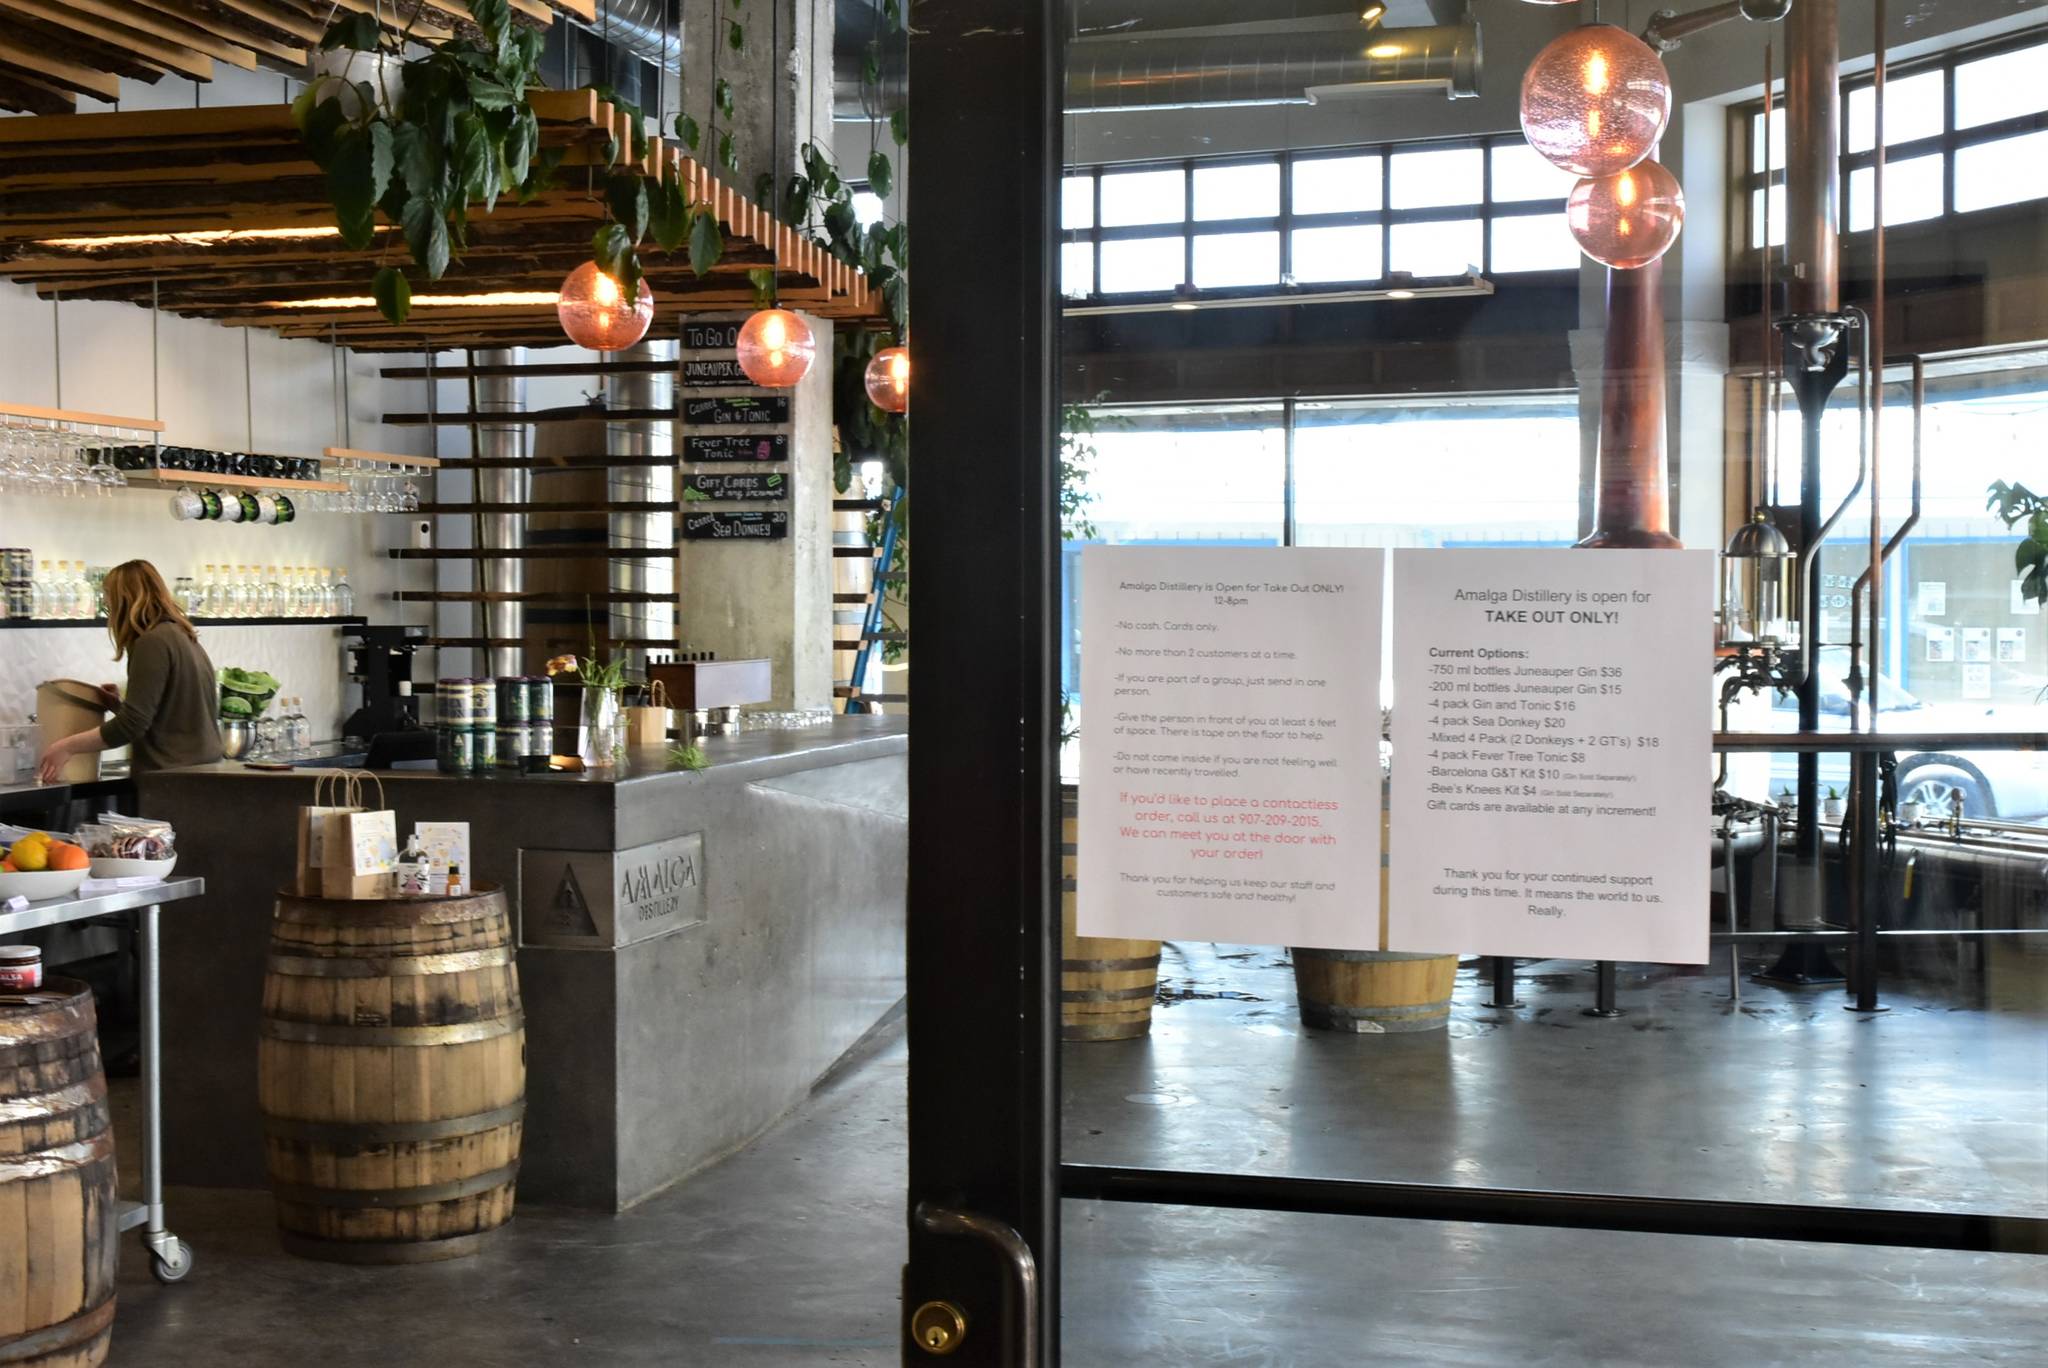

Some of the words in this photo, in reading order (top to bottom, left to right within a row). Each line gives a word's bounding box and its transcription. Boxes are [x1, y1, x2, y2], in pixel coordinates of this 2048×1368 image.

[688, 328, 703, 346] To
[706, 328, 721, 346] Go
[686, 362, 733, 376] JUNEAUPER
[692, 438, 724, 448] Fever
[726, 437, 751, 447] Tree
[704, 449, 735, 458] Tonic
[714, 488, 724, 497] at
[688, 513, 715, 530] Canned
[734, 521, 771, 537] DONKEY
[1119, 581, 1156, 591] Amalga
[1159, 581, 1203, 592] Distillery
[1205, 582, 1213, 591] is
[1215, 582, 1243, 592] Open
[1245, 583, 1260, 591] for
[1263, 583, 1287, 592] Take
[1290, 583, 1309, 592] Out
[1214, 595, 1248, 606] 12-8pm
[1454, 588, 1507, 604] Amalga
[1512, 588, 1572, 604] Distillery
[1576, 590, 1587, 601] is
[1592, 592, 1627, 605] open
[1631, 590, 1651, 602] for
[1484, 610, 1527, 622] TAKE
[1532, 610, 1565, 623] OUT
[1163, 621, 1193, 630] Cards
[1429, 647, 1474, 657] Current
[1456, 665, 1470, 674] ml
[1473, 665, 1511, 675] bottles
[1513, 666, 1574, 678] Juneauper
[1576, 666, 1597, 676] Gin
[1600, 666, 1622, 677] $36
[1456, 682, 1470, 691] ml
[1473, 682, 1510, 692] bottles
[1513, 683, 1574, 695] Juneauper
[1576, 683, 1596, 694] Gin
[1600, 683, 1621, 694] $15
[1442, 698, 1469, 710] pack
[1471, 698, 1492, 709] Gin
[1494, 700, 1516, 709] and
[1519, 699, 1551, 710] Tonic
[1553, 700, 1575, 710] $16
[1442, 715, 1469, 727] pack
[1472, 715, 1494, 726] Sea
[1498, 716, 1540, 729] Donkey
[1544, 717, 1565, 728] $20
[1468, 733, 1475, 741] 4
[1479, 733, 1506, 743] Pack
[1524, 734, 1574, 747] Donkeys
[1588, 735, 1595, 745] 2
[1637, 736, 1659, 747] $18
[1441, 749, 1468, 761] pack
[1471, 749, 1504, 760] Fever
[1506, 750, 1533, 761] Tree
[1536, 751, 1568, 762] Tonic
[1570, 752, 1585, 762] $8
[1520, 768, 1535, 778] Kit
[1538, 768, 1560, 779] $10
[1465, 784, 1501, 794] Knees
[1504, 785, 1519, 795] Kit
[1522, 785, 1536, 795] $4
[1120, 791, 1128, 802] If
[1168, 793, 1191, 805] like
[1193, 795, 1208, 805] to
[1211, 795, 1247, 808] place
[1250, 799, 1259, 807] a
[1262, 798, 1338, 810] contactless
[1426, 799, 1446, 809] Gift
[1449, 800, 1480, 811] cards
[1483, 803, 1502, 811] are
[1504, 802, 1555, 813] available
[1557, 804, 1569, 813] at
[1571, 806, 1593, 816] any
[1176, 811, 1200, 822] call
[1203, 814, 1218, 823] us
[1222, 814, 1235, 823] at
[1119, 826, 1139, 837] We
[1142, 829, 1166, 838] can
[1170, 829, 1201, 839] meet
[1204, 831, 1229, 843] you
[1232, 831, 1246, 841] at
[1249, 831, 1271, 842] the
[1273, 832, 1305, 844] door
[1309, 833, 1336, 844] with
[1190, 848, 1219, 859] your
[622, 855, 696, 904] AMALGA
[1120, 872, 1149, 882] Thank
[1152, 876, 1171, 884] you
[1172, 875, 1187, 884] for
[1189, 876, 1227, 887] helping
[1243, 879, 1267, 888] keep
[1290, 880, 1312, 889] staff
[1314, 882, 1335, 890] and
[1443, 868, 1478, 878] Thank
[1481, 871, 1502, 882] you
[1504, 869, 1520, 880] for
[1522, 873, 1548, 883] your
[1551, 872, 1606, 883] continued
[1609, 875, 1652, 887] support
[1156, 889, 1208, 898] customers
[1210, 890, 1231, 899] safe
[1233, 892, 1254, 900] and
[1432, 884, 1468, 897] during
[1470, 886, 1491, 896] this
[1524, 888, 1532, 897] It
[1535, 890, 1573, 899] means
[1576, 890, 1594, 900] the
[1597, 891, 1628, 901] world
[1631, 892, 1642, 902] to
